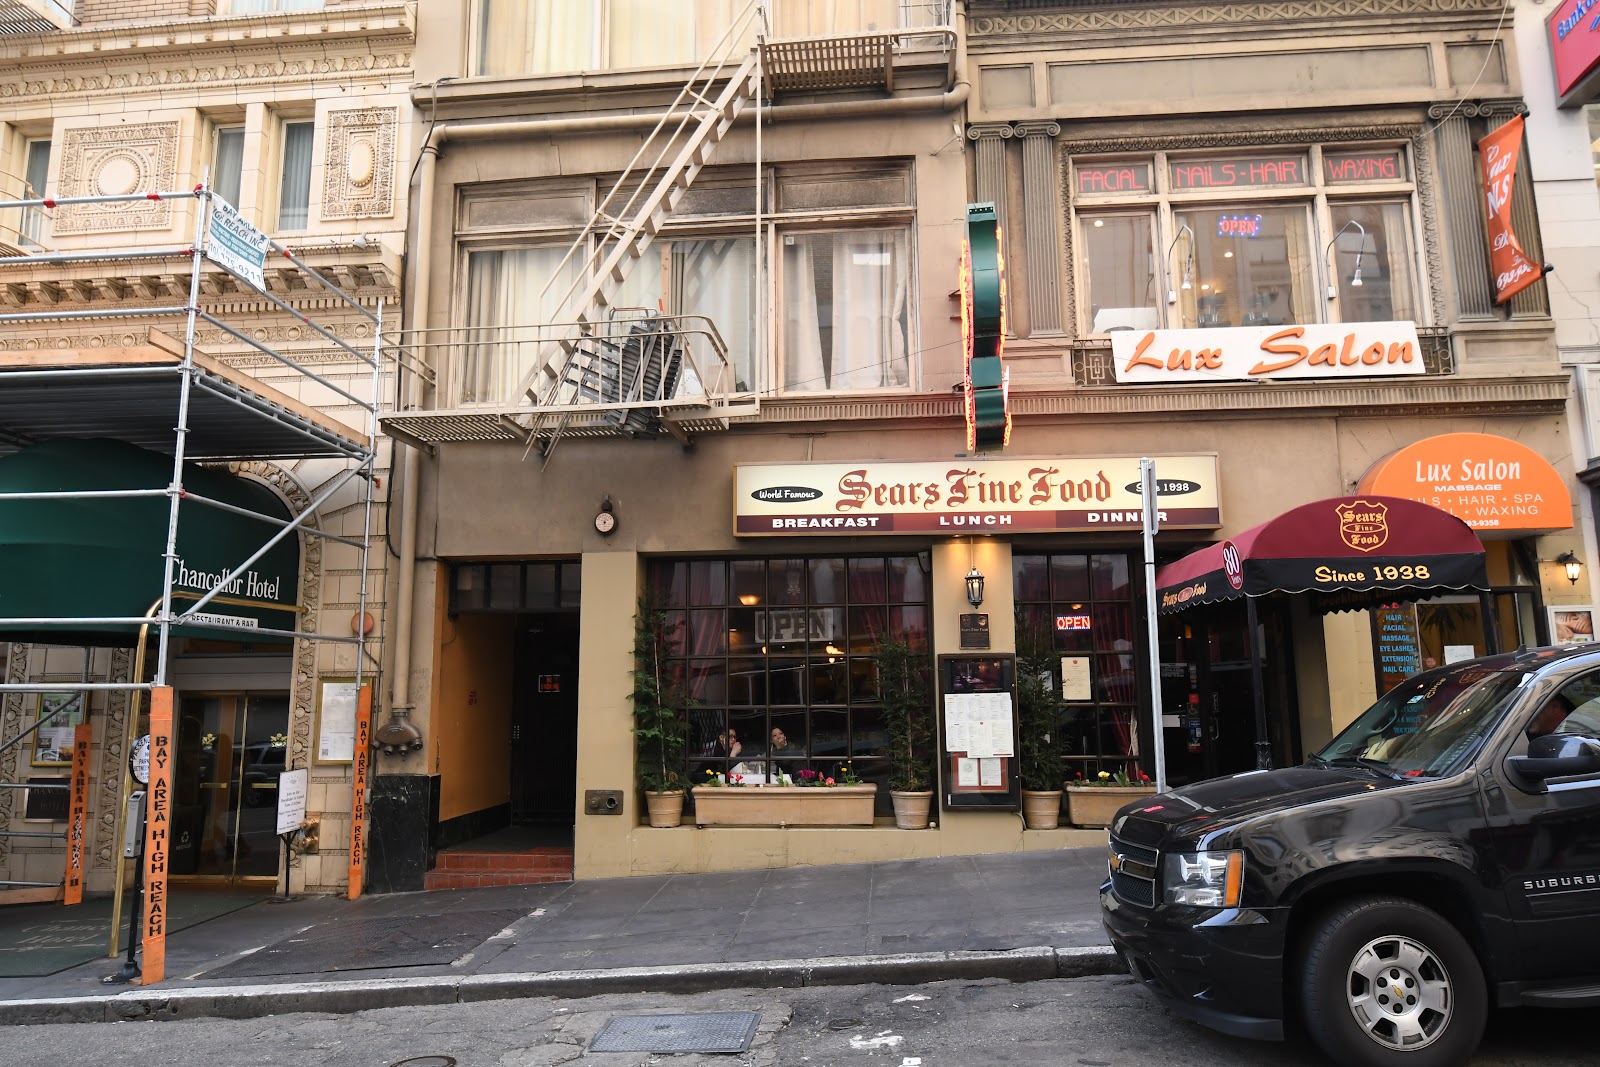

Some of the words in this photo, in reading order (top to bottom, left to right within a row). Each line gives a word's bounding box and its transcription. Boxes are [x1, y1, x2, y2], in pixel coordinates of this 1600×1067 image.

[1558, 1, 1586, 41] Bank
[1250, 161, 1297, 183] HAIR
[1329, 157, 1395, 179] WAXING
[1079, 169, 1144, 191] FACIAL
[222, 204, 238, 217] BAY
[224, 218, 248, 240] REACH
[1221, 219, 1256, 233] OPEN
[1124, 332, 1224, 373] Lux
[1248, 327, 1413, 375] Salon
[1415, 460, 1451, 483] Lux
[1460, 458, 1521, 482] Salon
[759, 489, 783, 499] World
[784, 489, 815, 499] Famous
[835, 469, 940, 512] Sears
[945, 467, 1023, 508] Fine
[1027, 466, 1111, 506] Food
[1163, 483, 1190, 492] 1938
[1434, 484, 1502, 492] MASSAGE
[1458, 495, 1496, 505] HAIR
[1513, 493, 1544, 504] SPA
[939, 514, 1012, 526] LUNCH
[1087, 511, 1168, 523] DINNR
[1342, 510, 1383, 523] Sears
[1475, 505, 1539, 516] WAXING
[772, 517, 879, 528] BREAKFAST
[1354, 524, 1374, 532] Fine
[1351, 534, 1379, 545] Food
[1223, 545, 1240, 575] 80
[1315, 565, 1366, 582] Since
[1372, 565, 1430, 581] 1938
[245, 571, 280, 600] Hotel
[241, 620, 254, 628] BAR
[757, 612, 831, 640] OPEN
[1056, 617, 1091, 629] OPEN
[1383, 665, 1397, 673] NAIL
[156, 736, 168, 769] BAY
[358, 751, 366, 784] AREA
[154, 778, 167, 822] AREA
[355, 788, 363, 820] HIGH
[151, 829, 165, 873] HIGH
[353, 825, 362, 866] REACH
[1523, 874, 1600, 890] SUBURB
[149, 881, 163, 936] REACH
